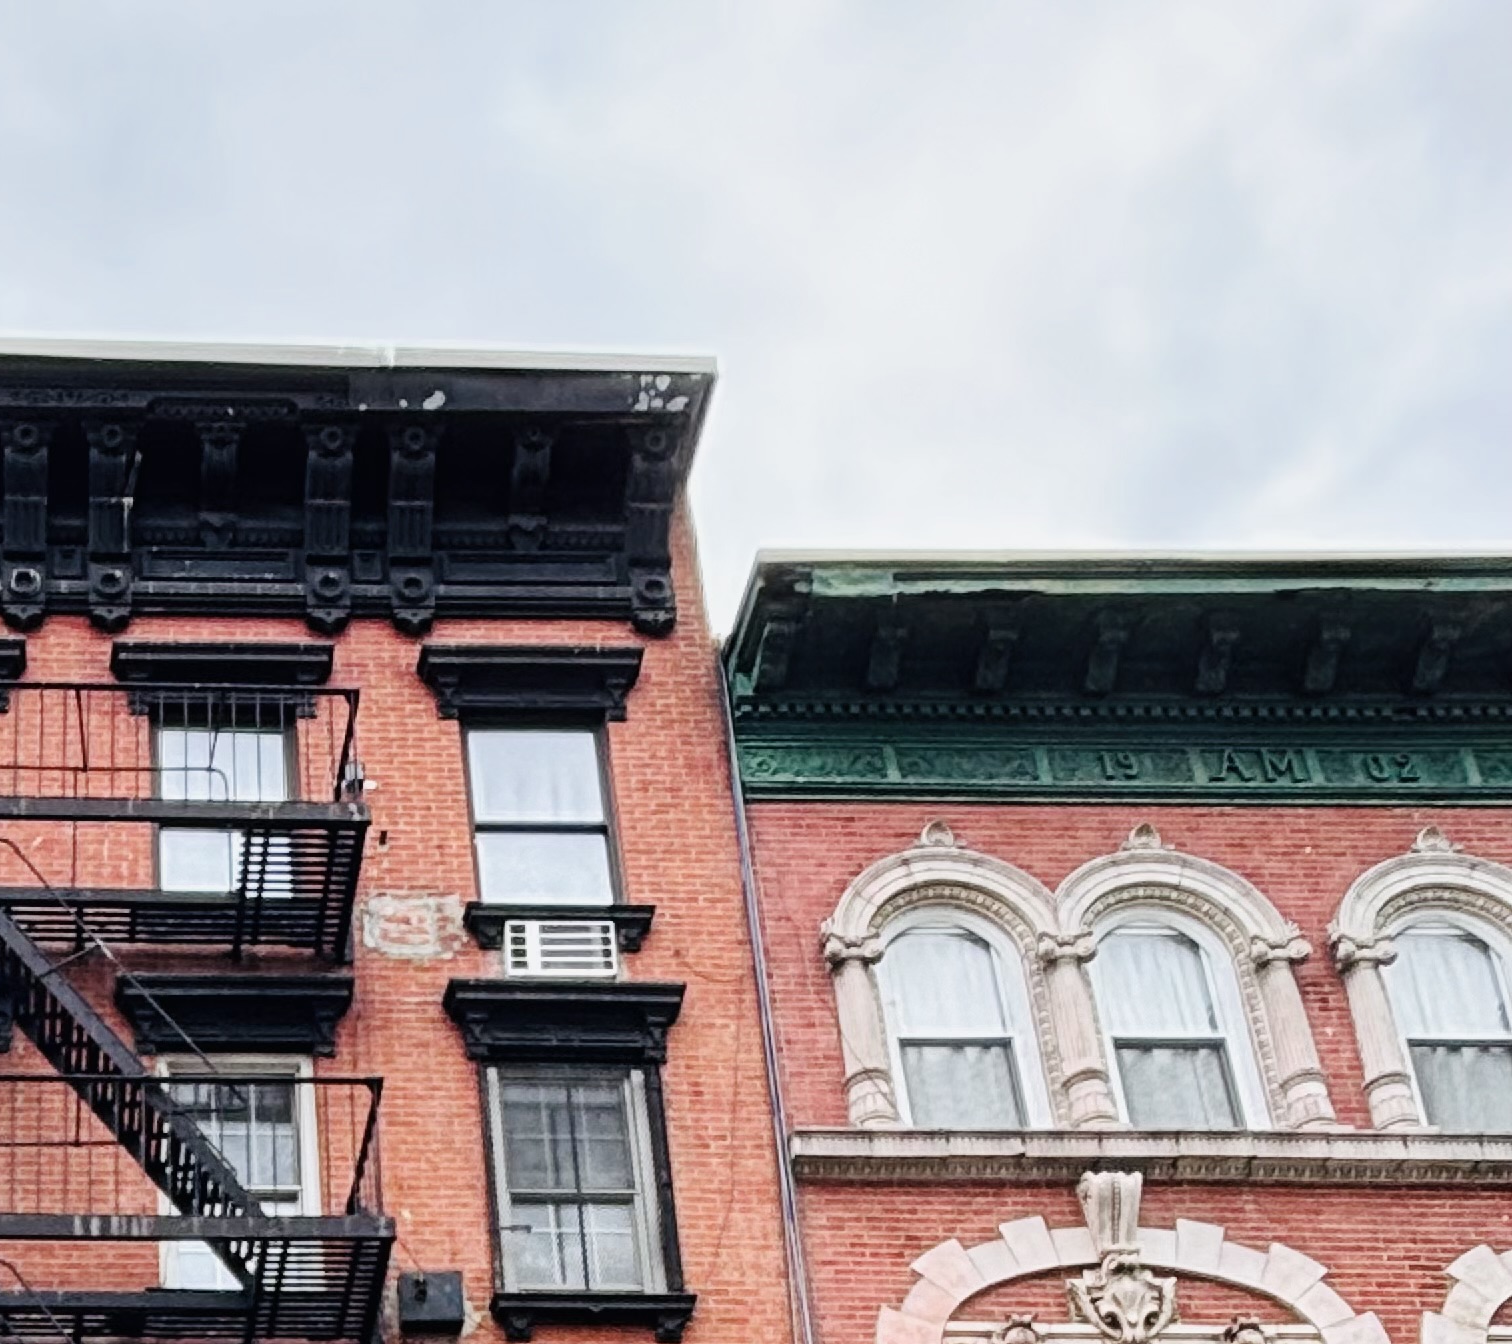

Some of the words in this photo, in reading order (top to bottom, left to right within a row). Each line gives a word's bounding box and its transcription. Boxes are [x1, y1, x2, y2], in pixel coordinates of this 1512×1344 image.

[1097, 750, 1139, 781] 19
[1208, 749, 1309, 783] AM
[1363, 751, 1421, 783] 02
